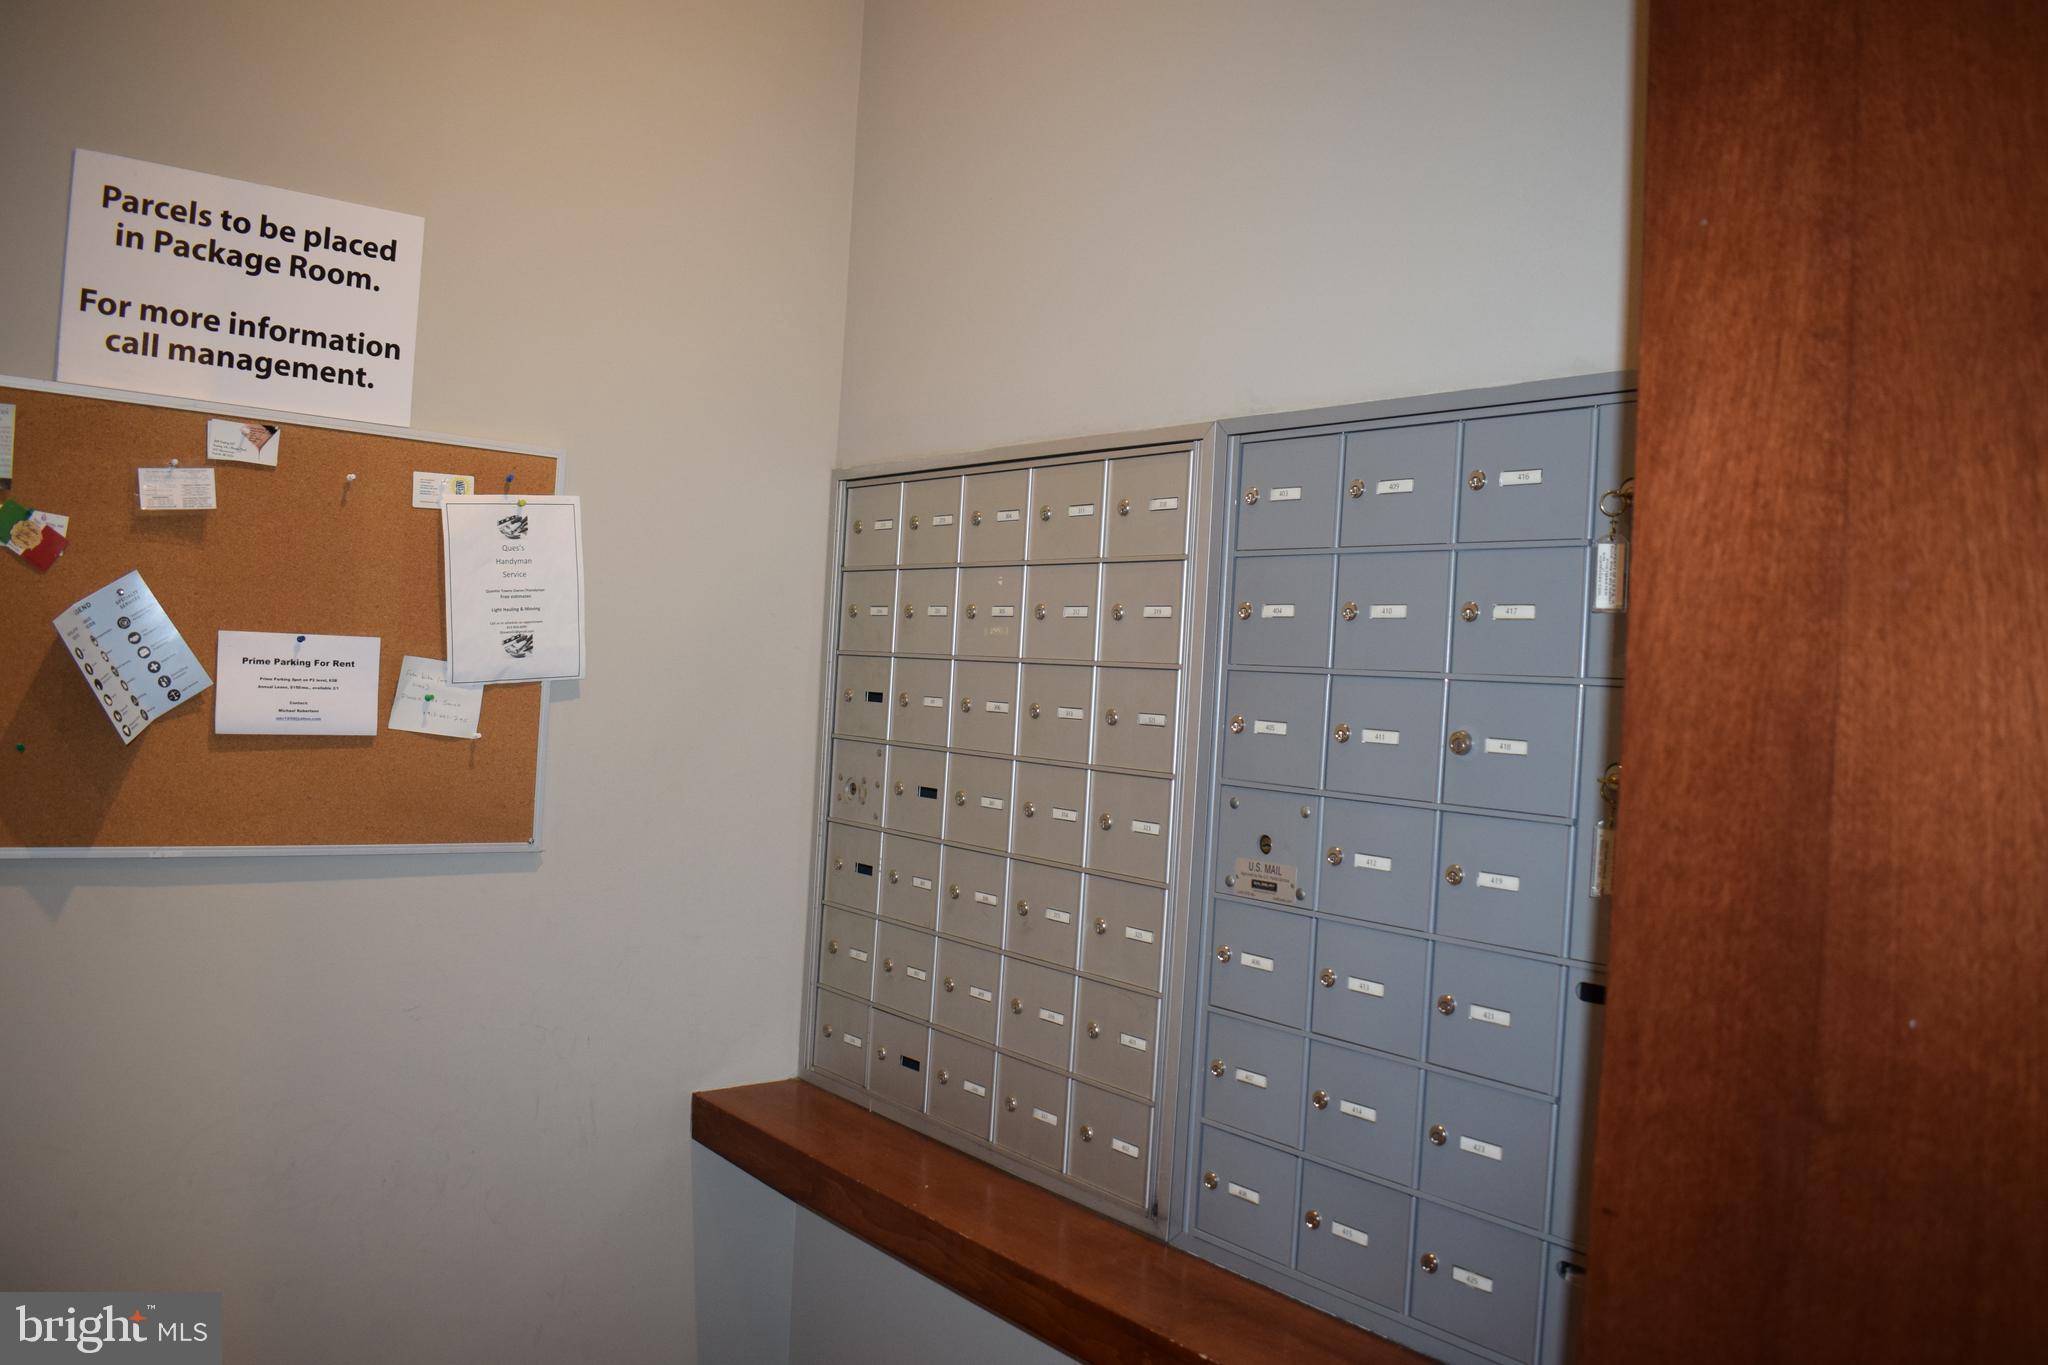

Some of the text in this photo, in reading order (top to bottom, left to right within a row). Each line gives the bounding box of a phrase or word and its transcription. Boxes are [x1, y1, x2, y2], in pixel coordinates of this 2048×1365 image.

[101, 184, 398, 262] Parcels to be placed
[116, 222, 380, 292] in Package Room.
[79, 287, 401, 360] For more information
[105, 332, 374, 389] call management.
[242, 657, 355, 668] Prime Parking For Rent
[1248, 861, 1282, 876] U.S. MAIL
